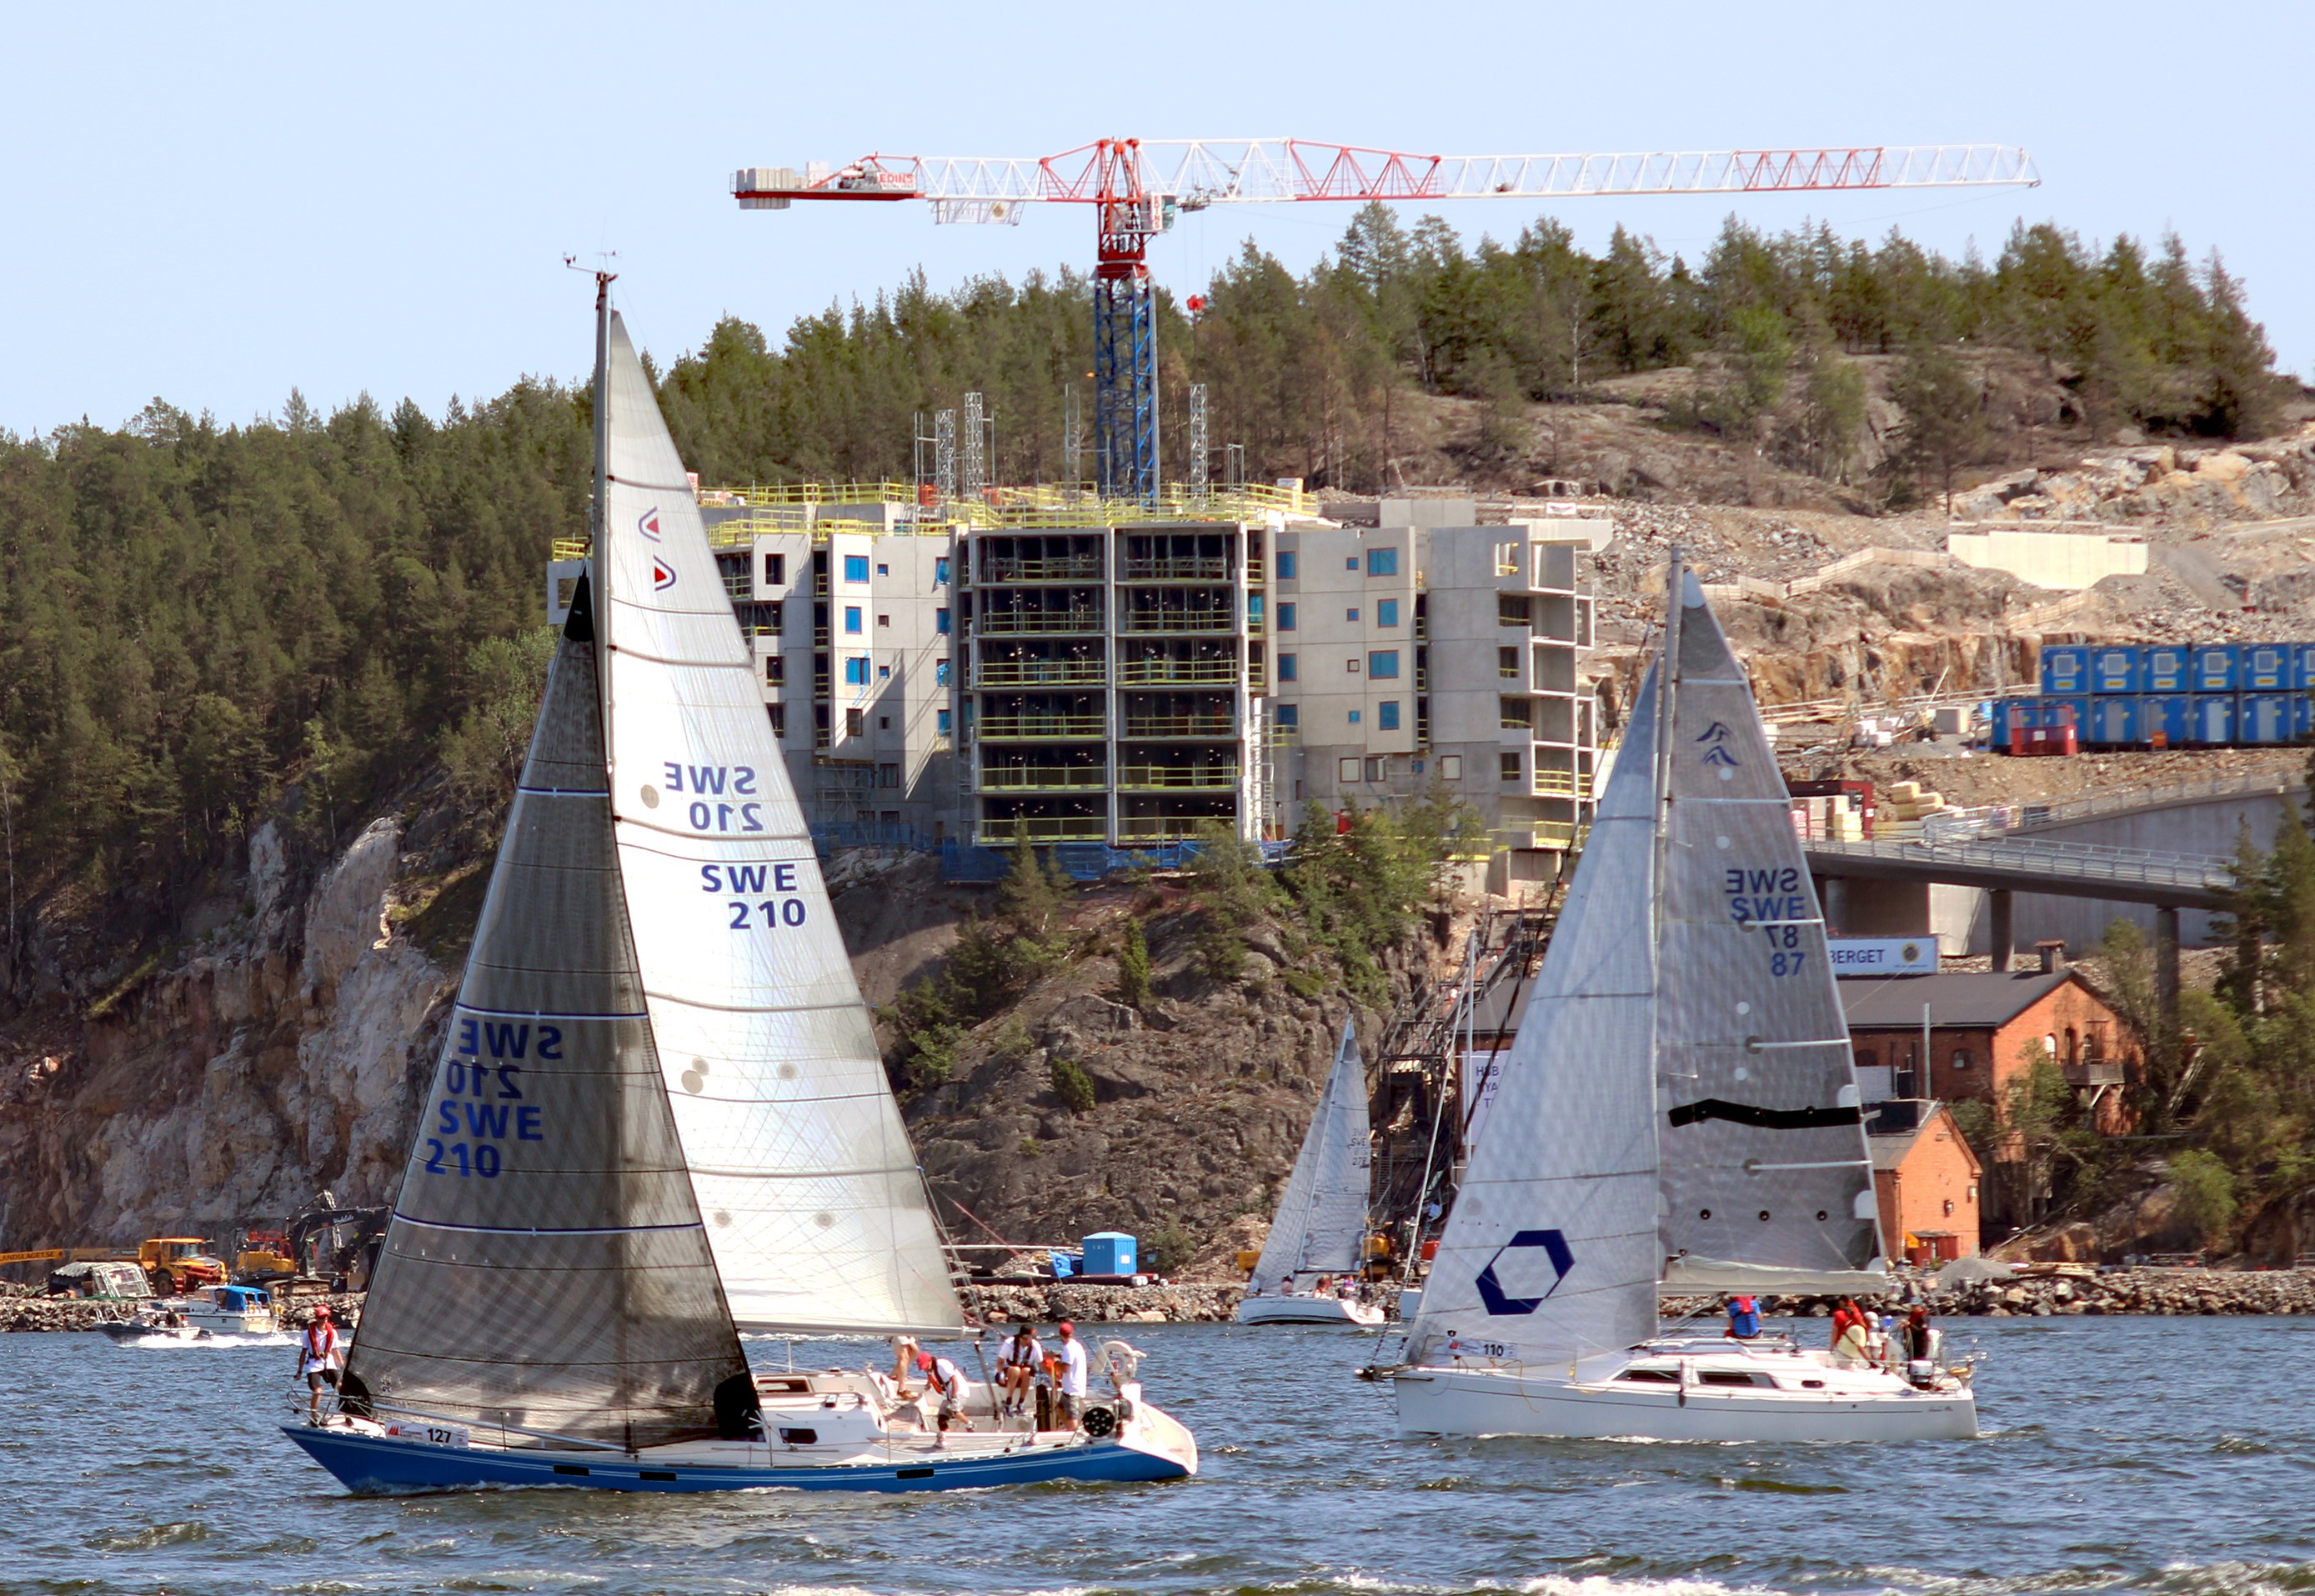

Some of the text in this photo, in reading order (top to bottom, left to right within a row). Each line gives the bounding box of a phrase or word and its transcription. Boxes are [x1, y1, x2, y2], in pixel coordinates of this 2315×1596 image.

[879, 173, 914, 183] EDINS
[701, 863, 797, 893] SWE
[729, 898, 806, 930] 210
[1731, 896, 1806, 922] SWE
[1771, 953, 1806, 977] 87
[1476, 1066, 1499, 1077] HB
[438, 1099, 544, 1141] SWE
[425, 1138, 501, 1178] 210
[1055, 1258, 1063, 1268] 5
[1483, 1343, 1504, 1357] 110
[427, 1428, 452, 1443] 127
